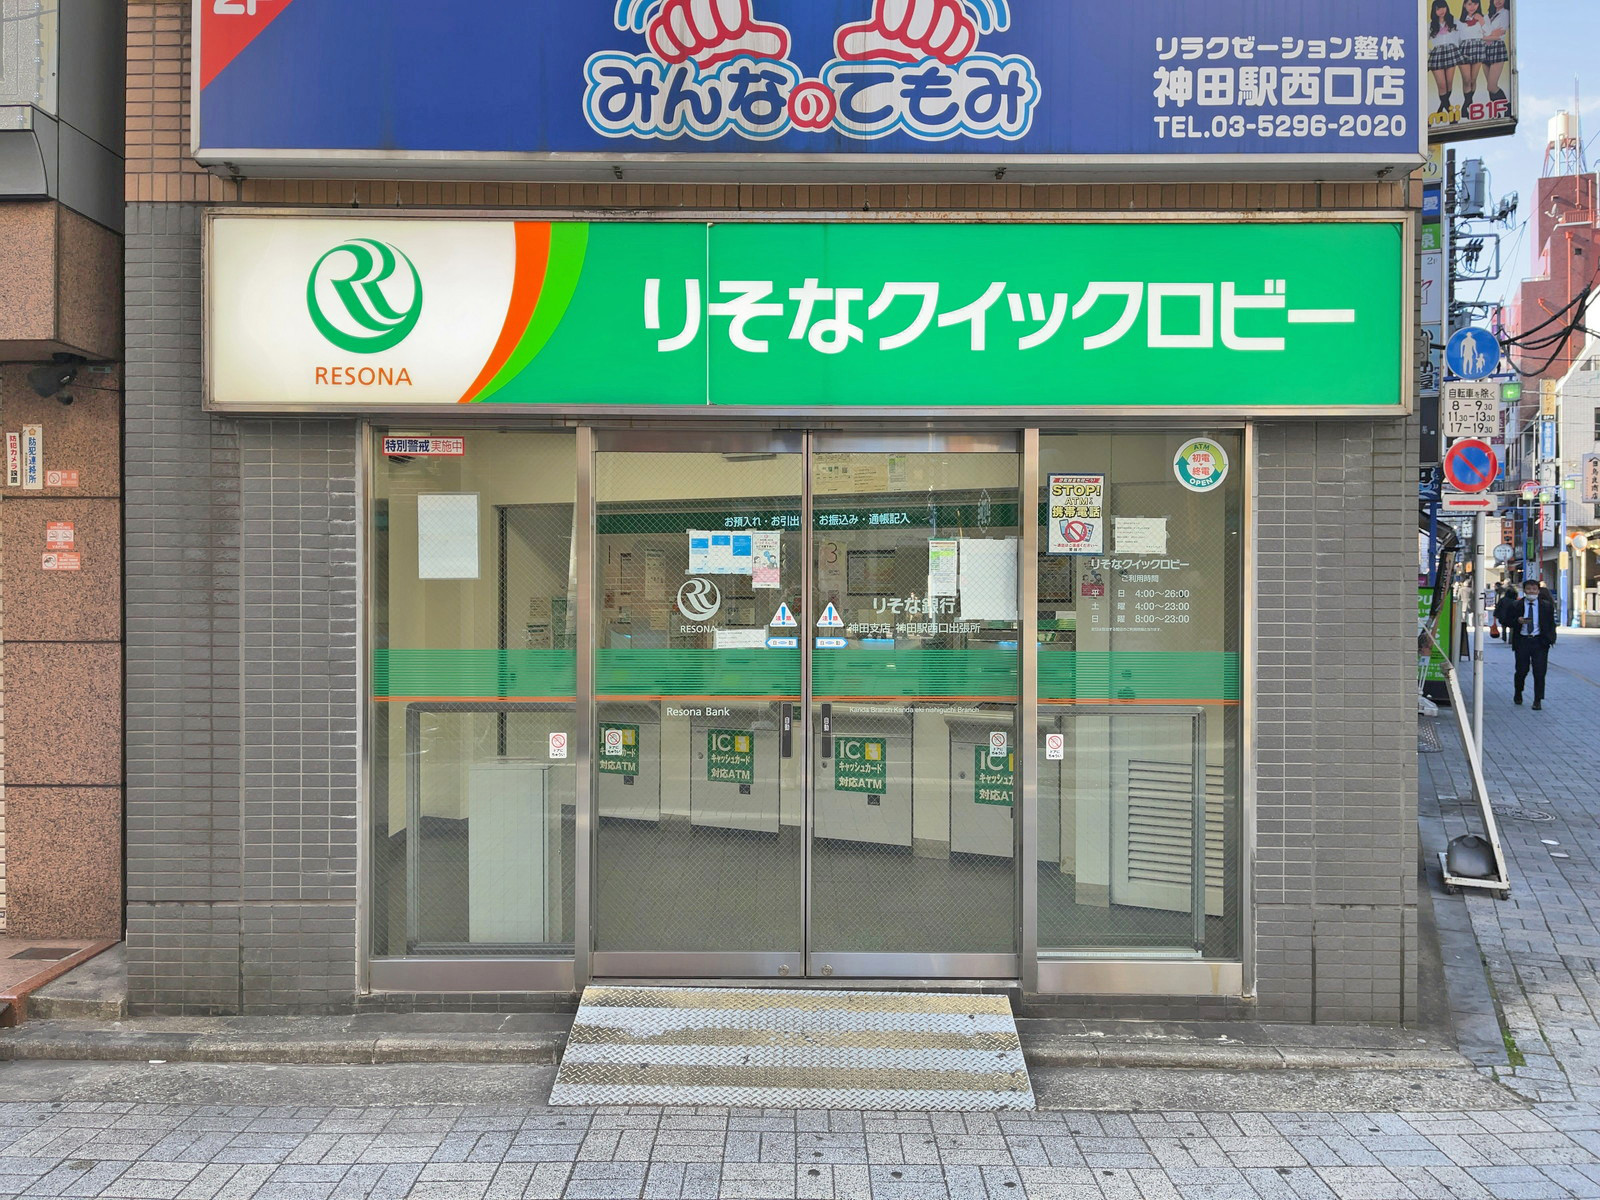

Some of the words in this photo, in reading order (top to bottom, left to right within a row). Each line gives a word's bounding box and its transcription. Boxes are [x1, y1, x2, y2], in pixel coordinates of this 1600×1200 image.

[1155, 36, 1405, 61] リラクゼーション整体
[1153, 66, 1406, 108] 神田駅西口店
[597, 65, 1028, 129] みんなのてもみ
[1469, 99, 1508, 120] B1F
[1153, 114, 1407, 138] TEL.03-5296-2020
[643, 277, 1355, 354] りそなクイックロビー
[315, 366, 412, 386] RESONA
[1448, 388, 1495, 399] 自転車を除く
[384, 439, 462, 453] 特別警戒実施中
[9, 435, 18, 484] 防犯カメラ設置
[28, 437, 37, 484] 防犯連絡所
[1192, 453, 1210, 463] 初電
[1190, 477, 1214, 486] OPEN
[1052, 484, 1101, 496] STOP!
[1052, 506, 1101, 519] 携帯電話
[1090, 558, 1190, 570] りそなクイックロビー
[1121, 574, 1159, 583] ご利用時間
[873, 597, 956, 615] りそな銀行
[680, 625, 718, 633] RESONA
[848, 622, 891, 634] 神田支店
[895, 622, 981, 634] 神田駅西口出張所
[666, 707, 702, 717] Resona
[705, 707, 730, 717] Bank
[711, 733, 731, 751] IC
[839, 741, 860, 759] IC
[600, 759, 636, 771] 対応ATM
[711, 753, 750, 765] キャッシュカード
[980, 751, 1004, 771] IC
[711, 767, 750, 780] 対応ATM
[838, 761, 882, 774] キャッシュカード
[838, 777, 882, 789] 対応ATM
